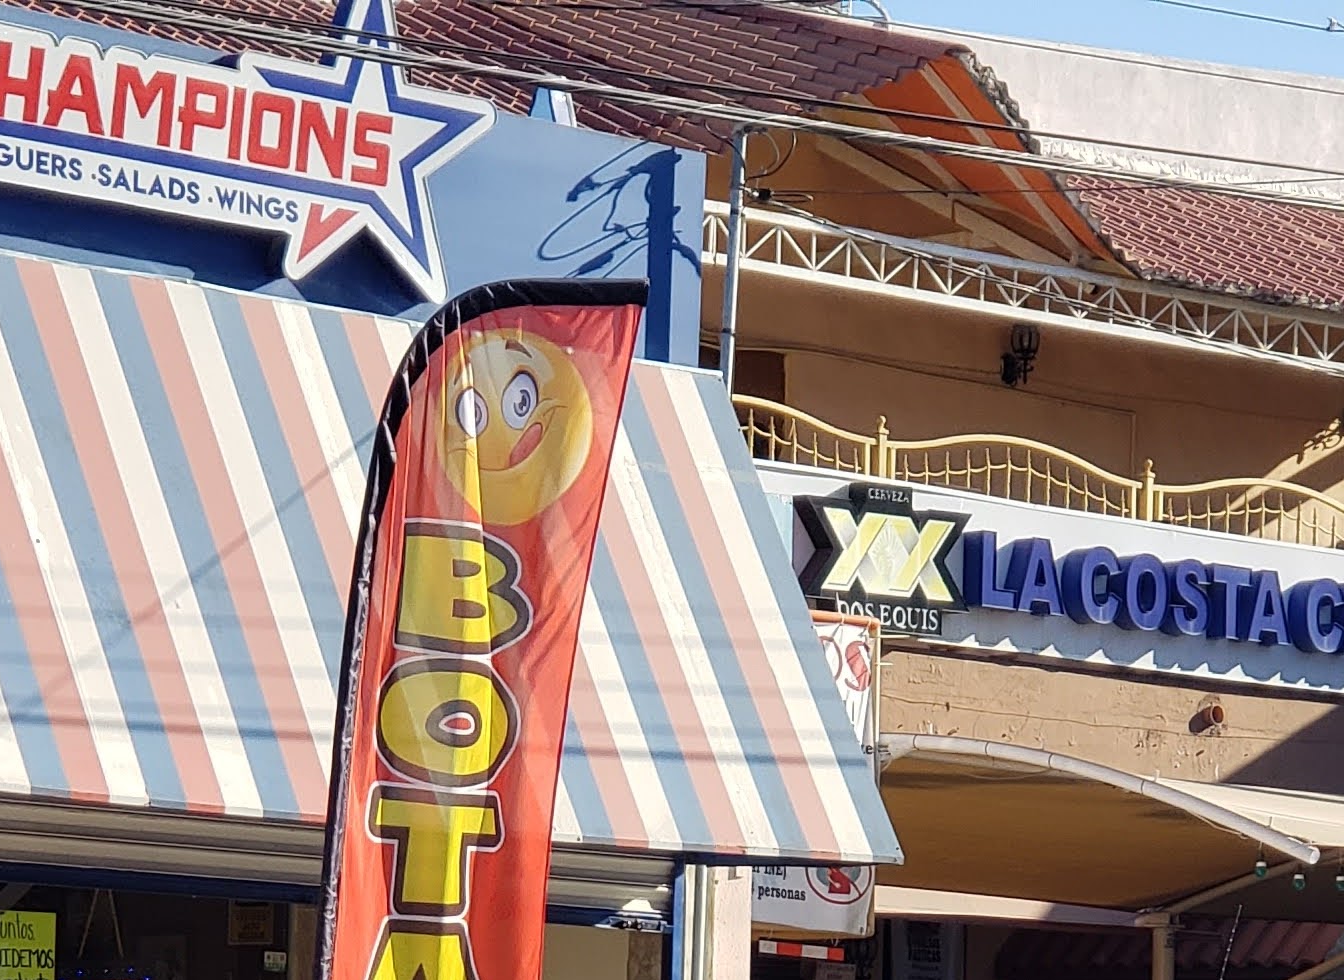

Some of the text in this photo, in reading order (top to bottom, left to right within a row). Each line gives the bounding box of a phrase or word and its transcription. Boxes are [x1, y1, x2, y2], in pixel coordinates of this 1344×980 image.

[97, 163, 200, 205] SALADS
[214, 185, 299, 223] WINGS
[867, 487, 910, 503] CERVEZA
[972, 530, 1064, 617] LA
[1071, 546, 1290, 646] COSTA
[880, 604, 940, 631] EQUIS
[757, 885, 806, 901] personas
